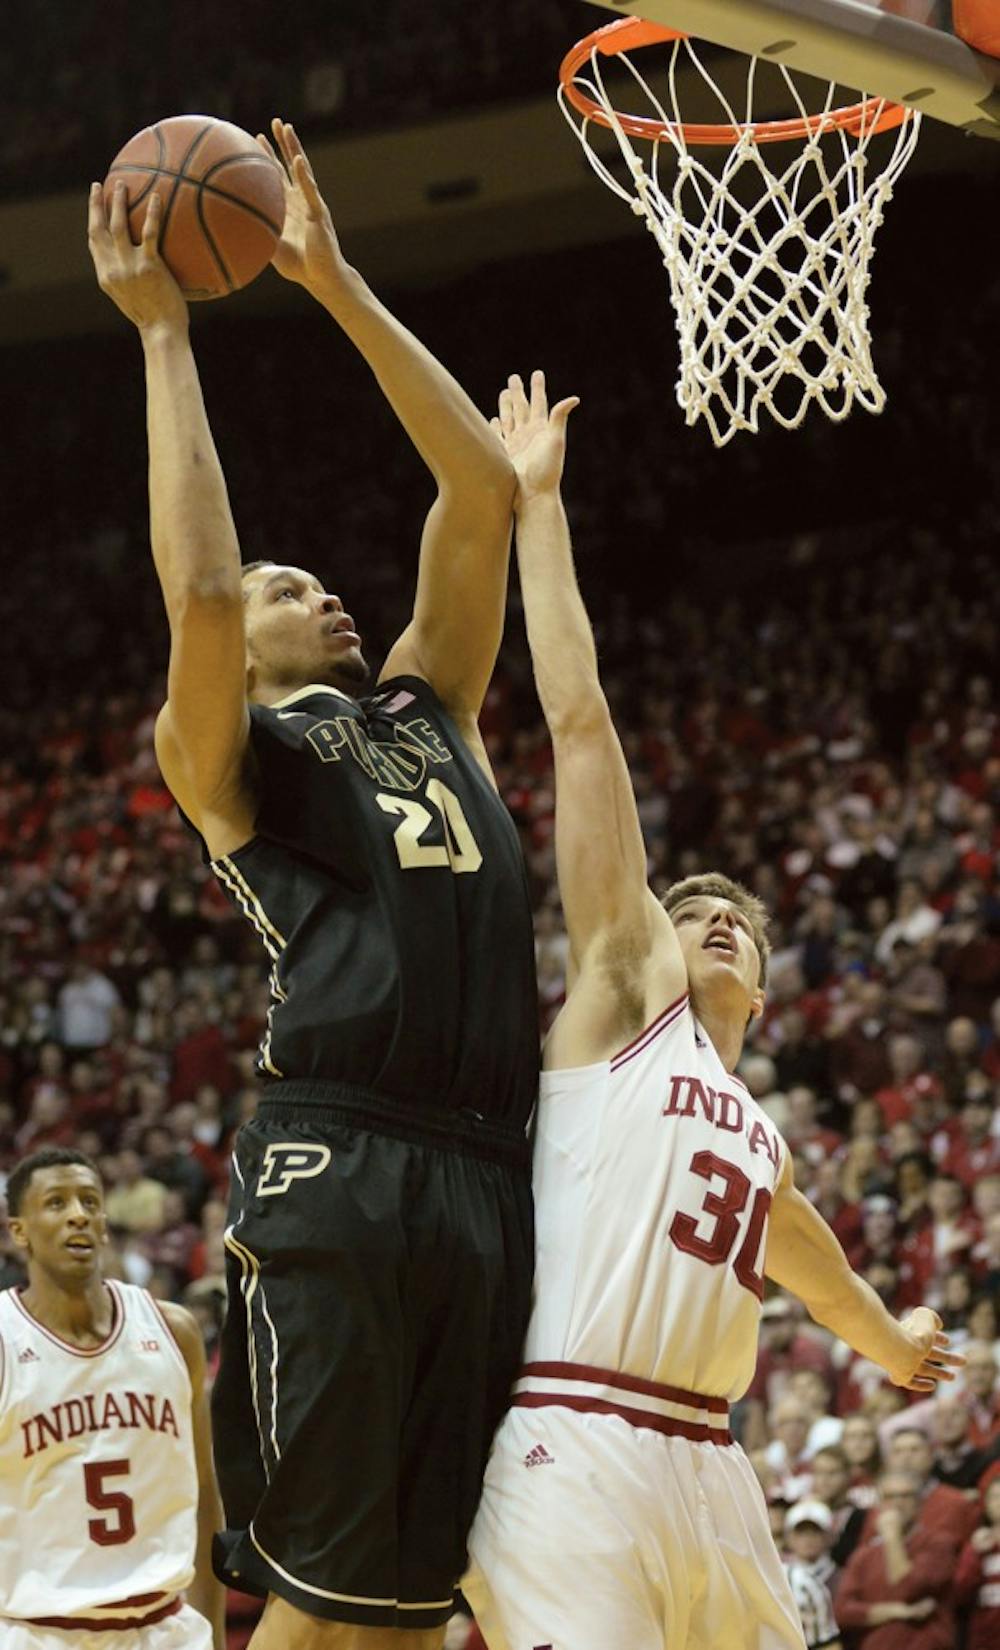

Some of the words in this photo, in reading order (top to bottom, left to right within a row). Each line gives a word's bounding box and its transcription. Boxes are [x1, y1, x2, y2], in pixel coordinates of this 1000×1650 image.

[375, 777, 483, 873] 20
[256, 1142, 331, 1197] P
[21, 1391, 180, 1459] INDIANA
[83, 1458, 136, 1546] 5
